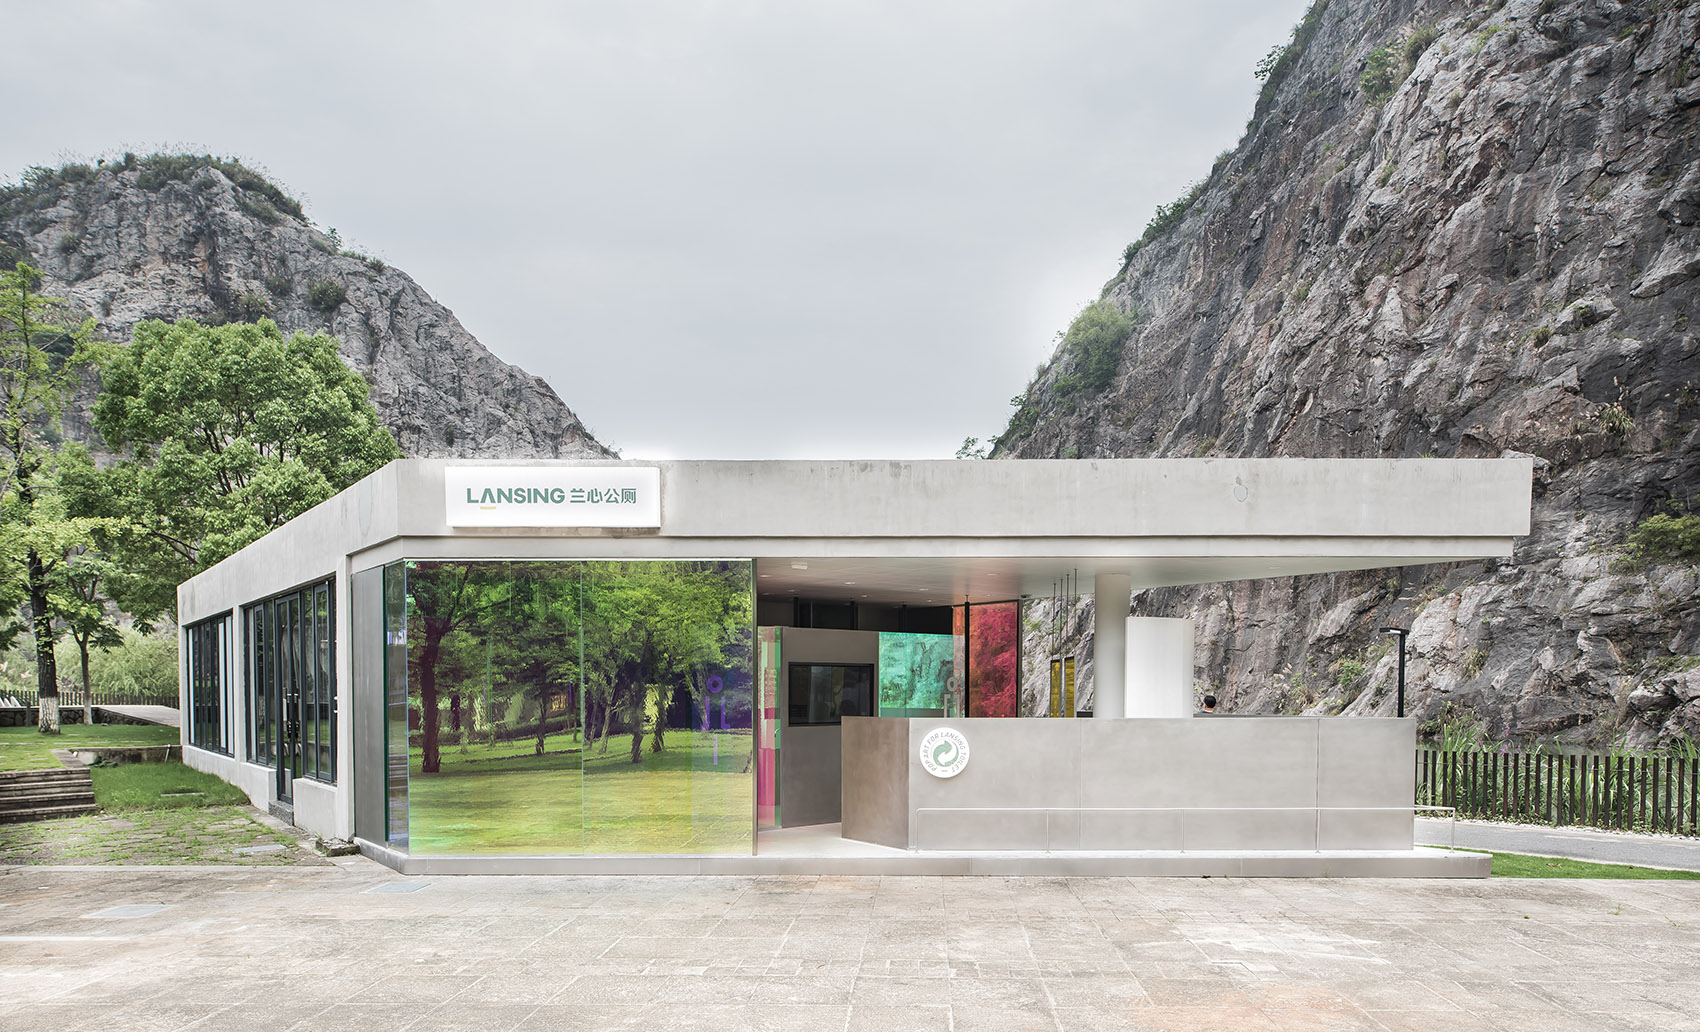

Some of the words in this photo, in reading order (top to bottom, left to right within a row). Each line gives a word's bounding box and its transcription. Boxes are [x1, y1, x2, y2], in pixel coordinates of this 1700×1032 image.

[466, 487, 565, 504] LANSING
[570, 487, 636, 504] 兰心公厕
[927, 732, 939, 745] FOR
[941, 732, 965, 750] LANSING
[925, 759, 937, 772] POP
[952, 752, 966, 773] TOILET
